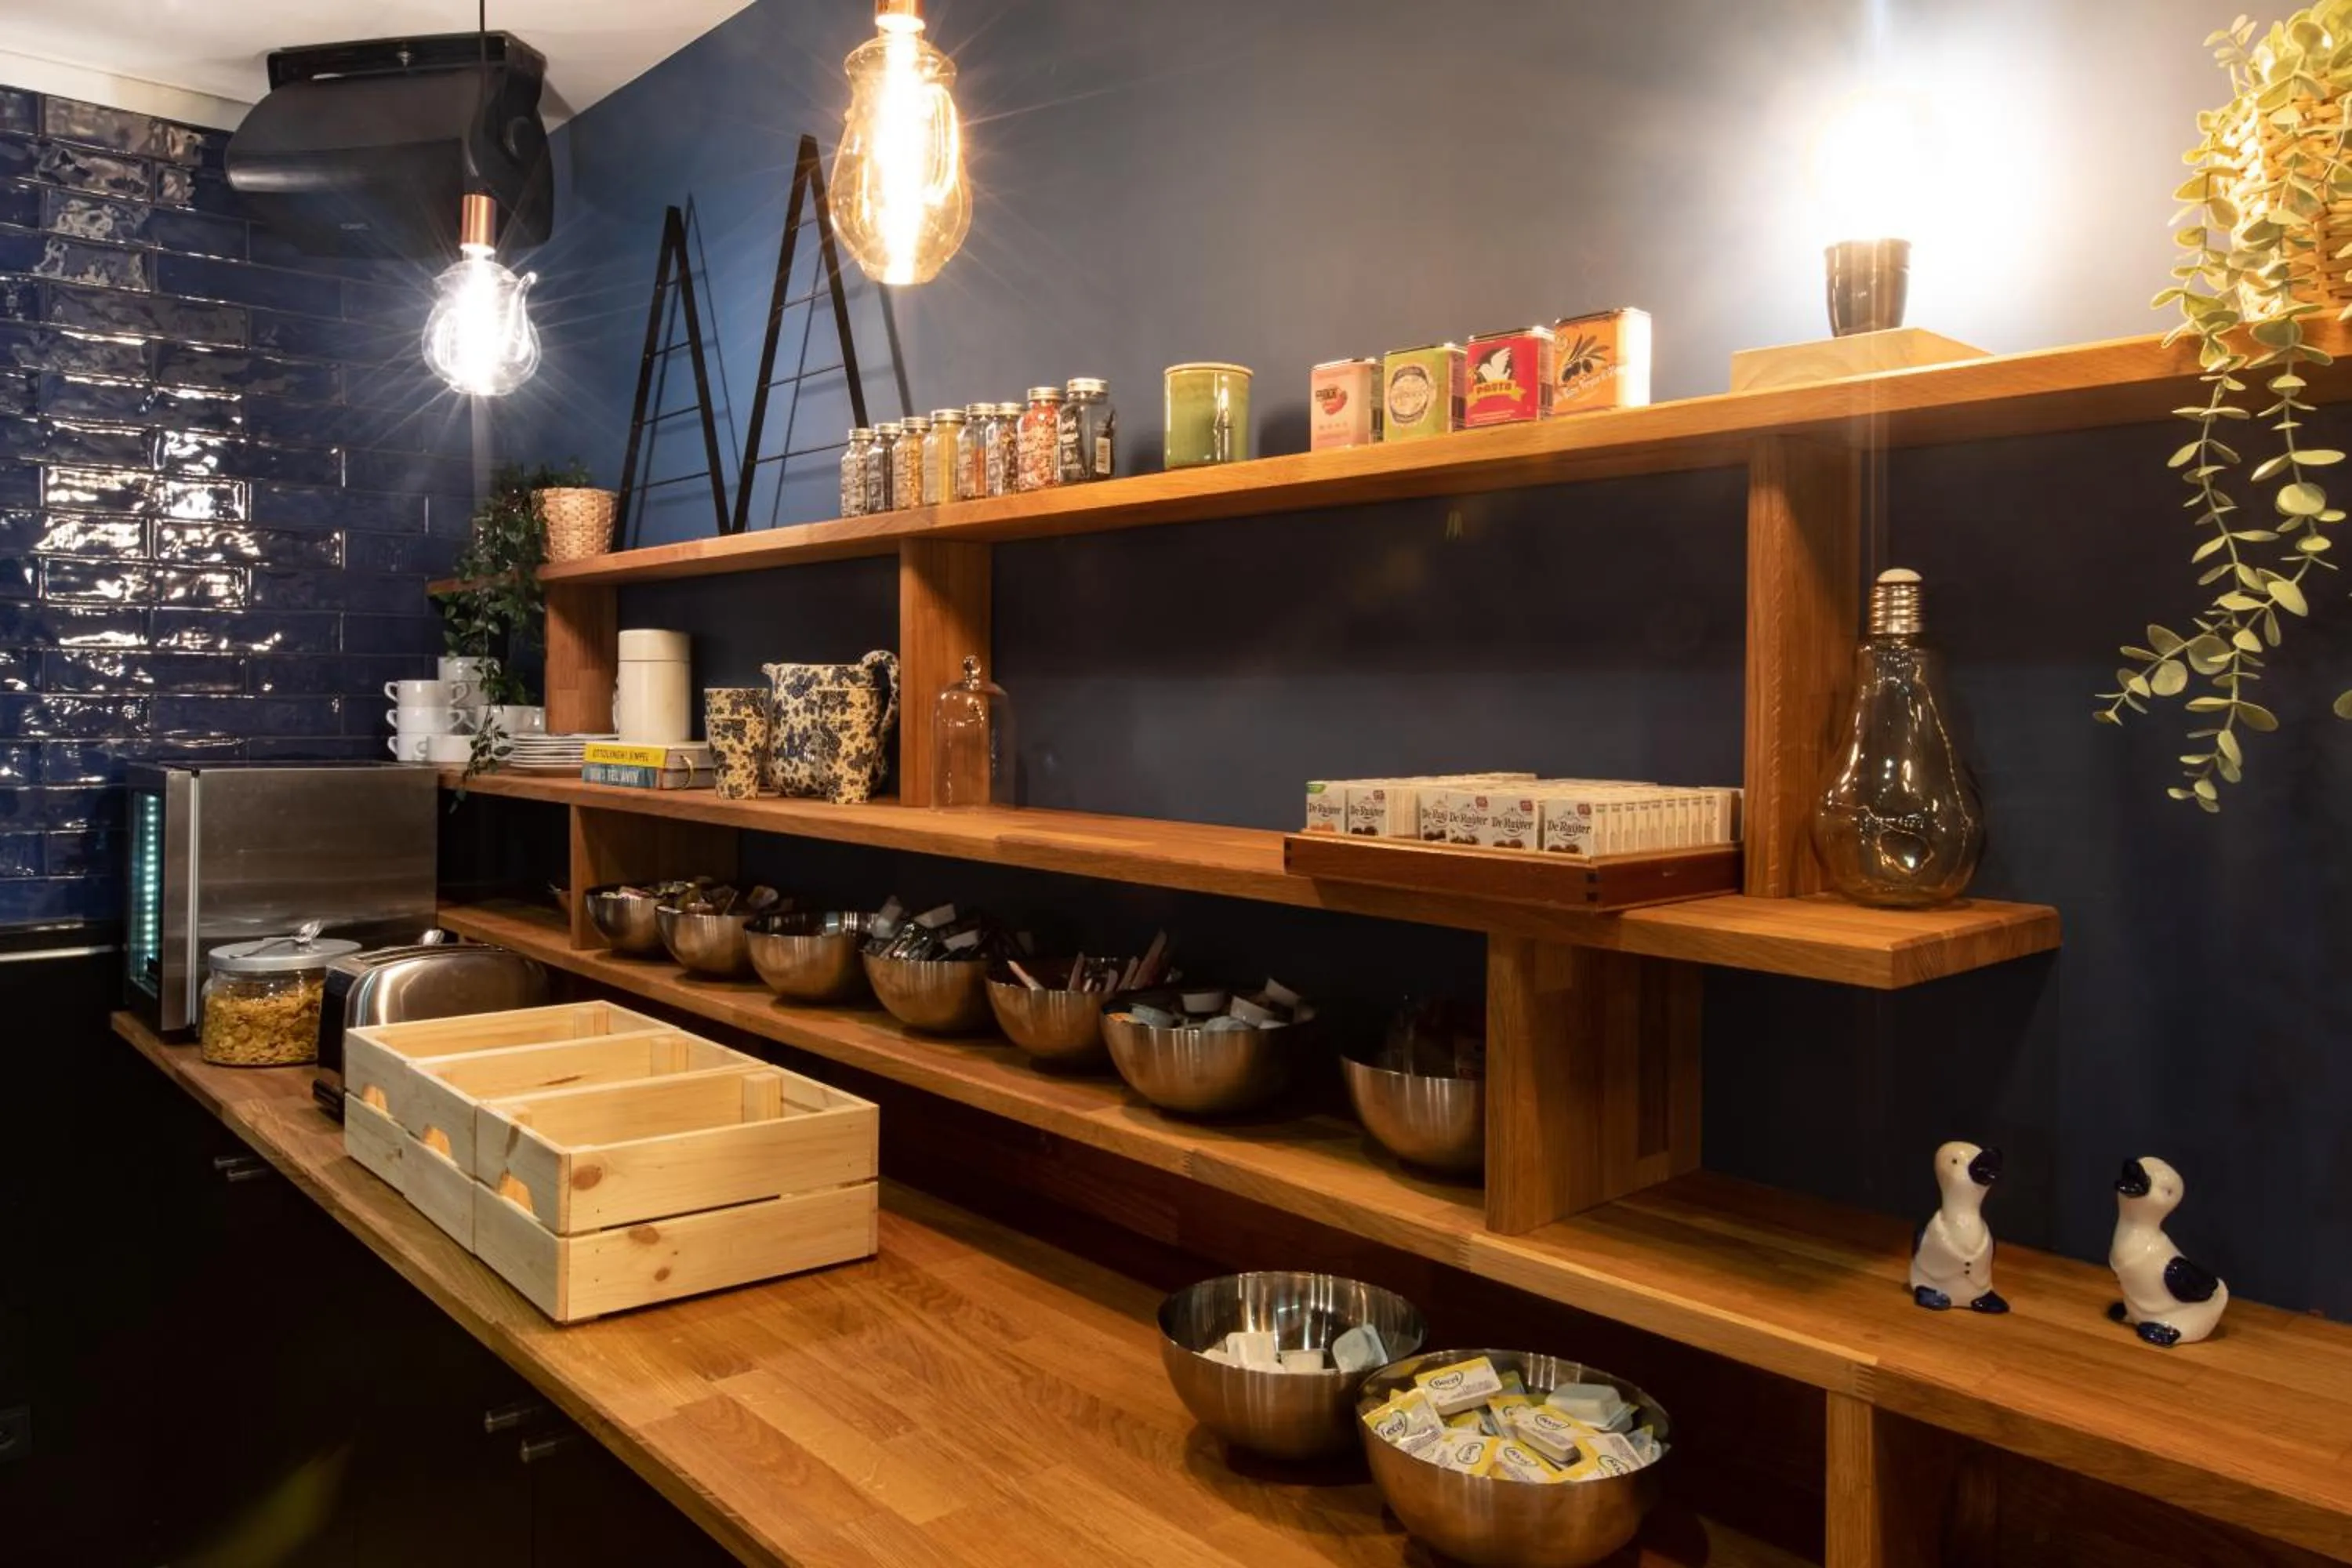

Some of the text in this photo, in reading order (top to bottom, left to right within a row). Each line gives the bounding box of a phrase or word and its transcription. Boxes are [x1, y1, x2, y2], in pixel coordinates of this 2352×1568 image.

[1308, 802, 1317, 813] De
[1350, 804, 1359, 815] De
[1421, 808, 1432, 819] De
[1450, 811, 1459, 822] De
[1491, 816, 1501, 828] De
[1547, 818, 1592, 833] De Ruijter
[1434, 1374, 1460, 1387] Becel
